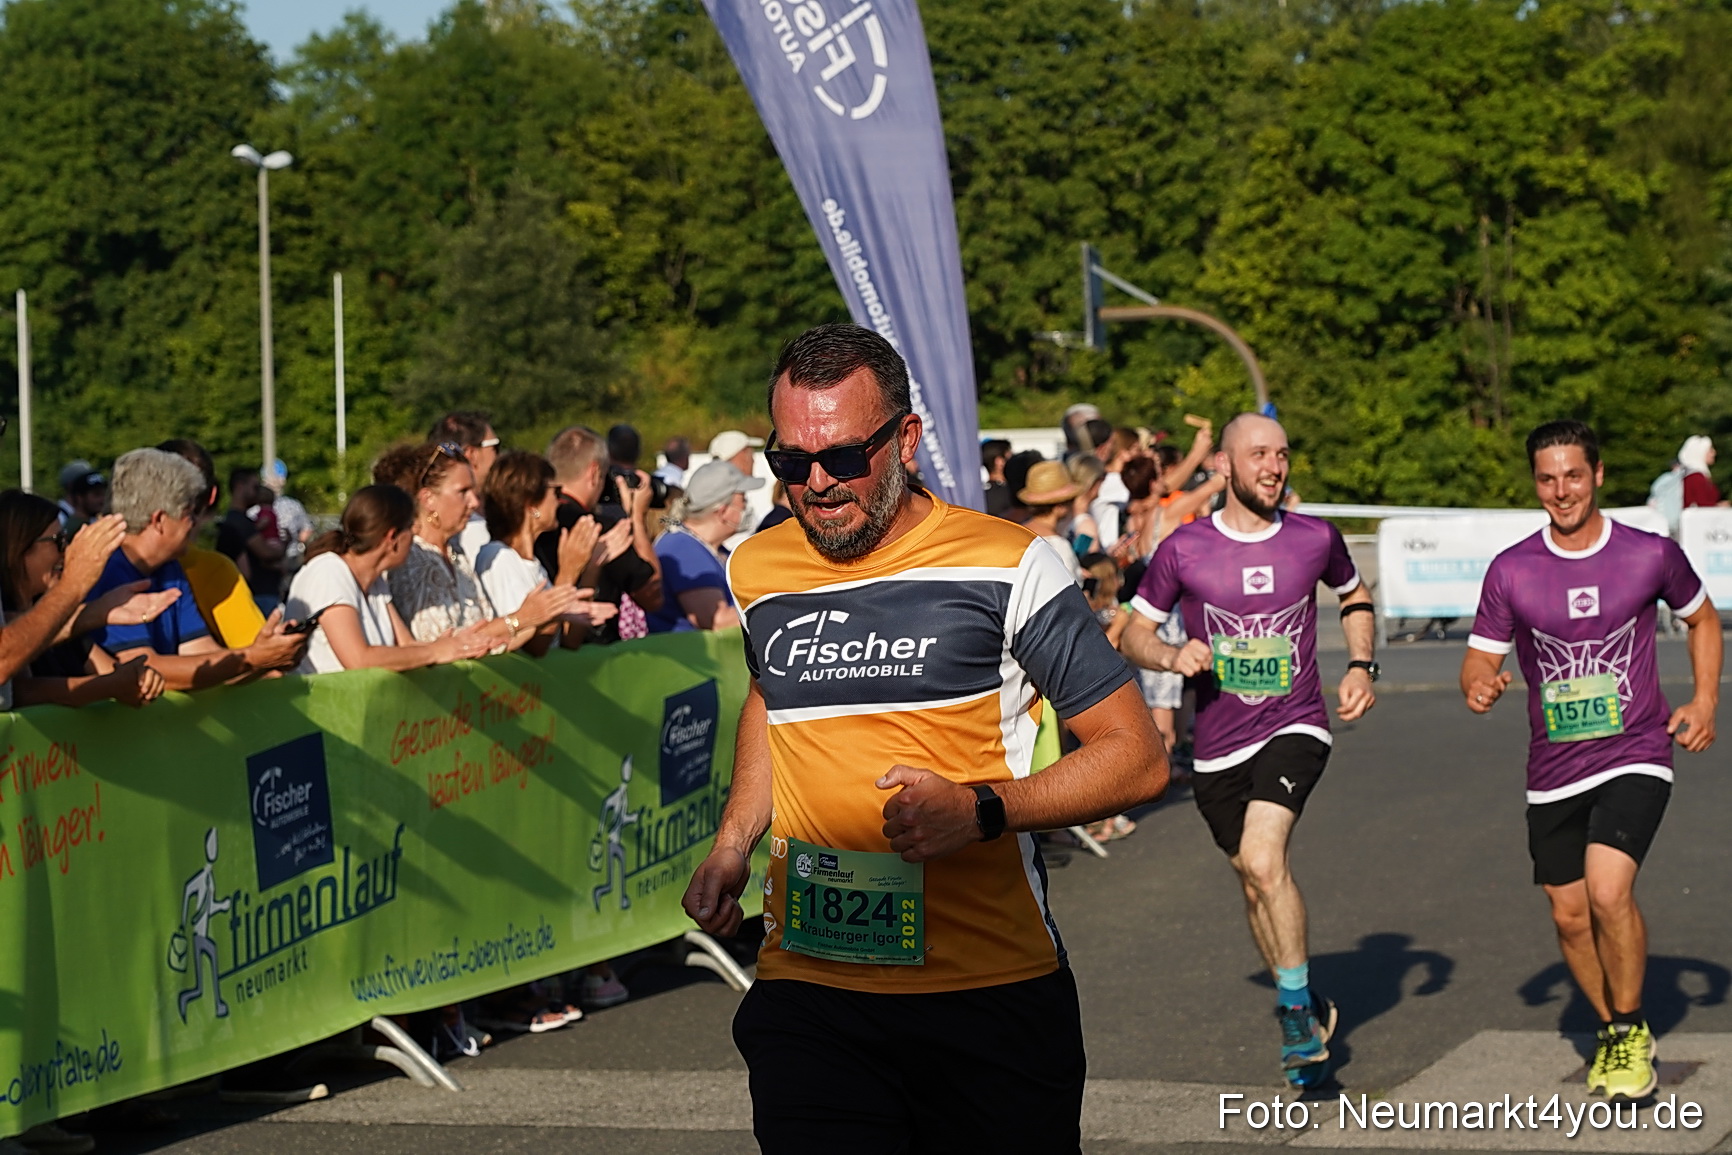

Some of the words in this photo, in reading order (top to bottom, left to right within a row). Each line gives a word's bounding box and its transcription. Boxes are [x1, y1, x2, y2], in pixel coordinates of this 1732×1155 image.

[786, 632, 938, 667] Fischer
[1226, 658, 1278, 677] 1540
[799, 664, 924, 683] AUTOMOBILE
[391, 692, 473, 766] Gesunde
[479, 682, 542, 730] Firmen
[1554, 696, 1607, 723] 1576
[264, 781, 313, 818] Fischer
[428, 750, 486, 810] laufen
[18, 782, 105, 875] länger!
[813, 866, 855, 879] Firmenlauf
[228, 823, 405, 971] firmenlauf
[791, 890, 801, 930] RUN
[804, 883, 898, 928] 1824
[800, 920, 869, 944] Krauberger
[873, 931, 901, 946] Igor
[902, 899, 915, 949] 2022
[235, 947, 309, 1004] neumarkt
